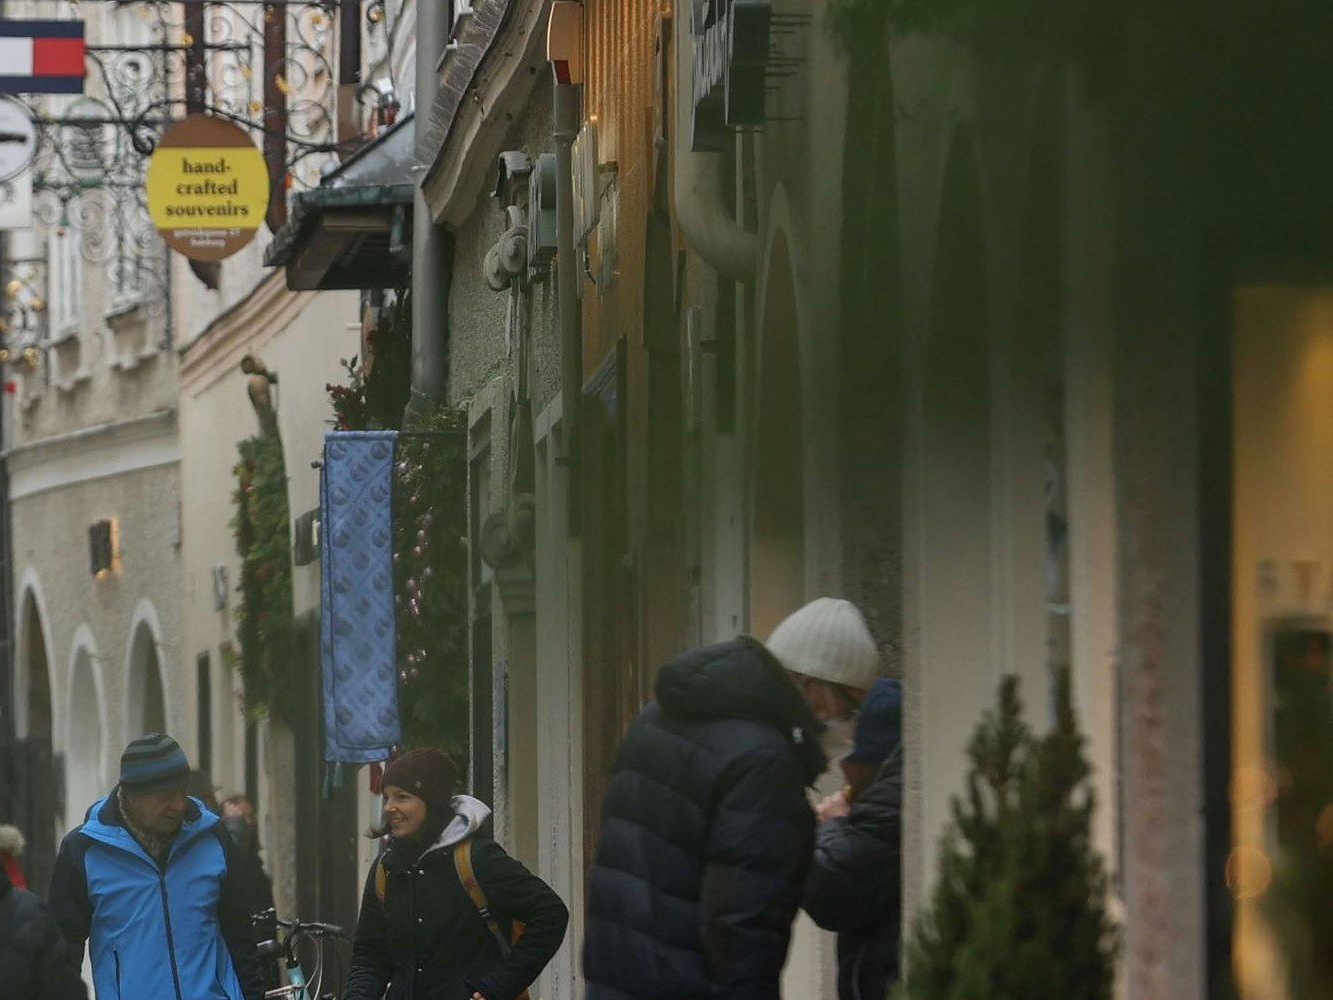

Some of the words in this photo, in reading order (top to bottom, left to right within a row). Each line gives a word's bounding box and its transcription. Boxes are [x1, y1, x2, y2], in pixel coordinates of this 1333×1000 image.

[182, 157, 230, 174] hand-
[176, 178, 238, 195] crafted
[165, 201, 249, 217] souvenirs
